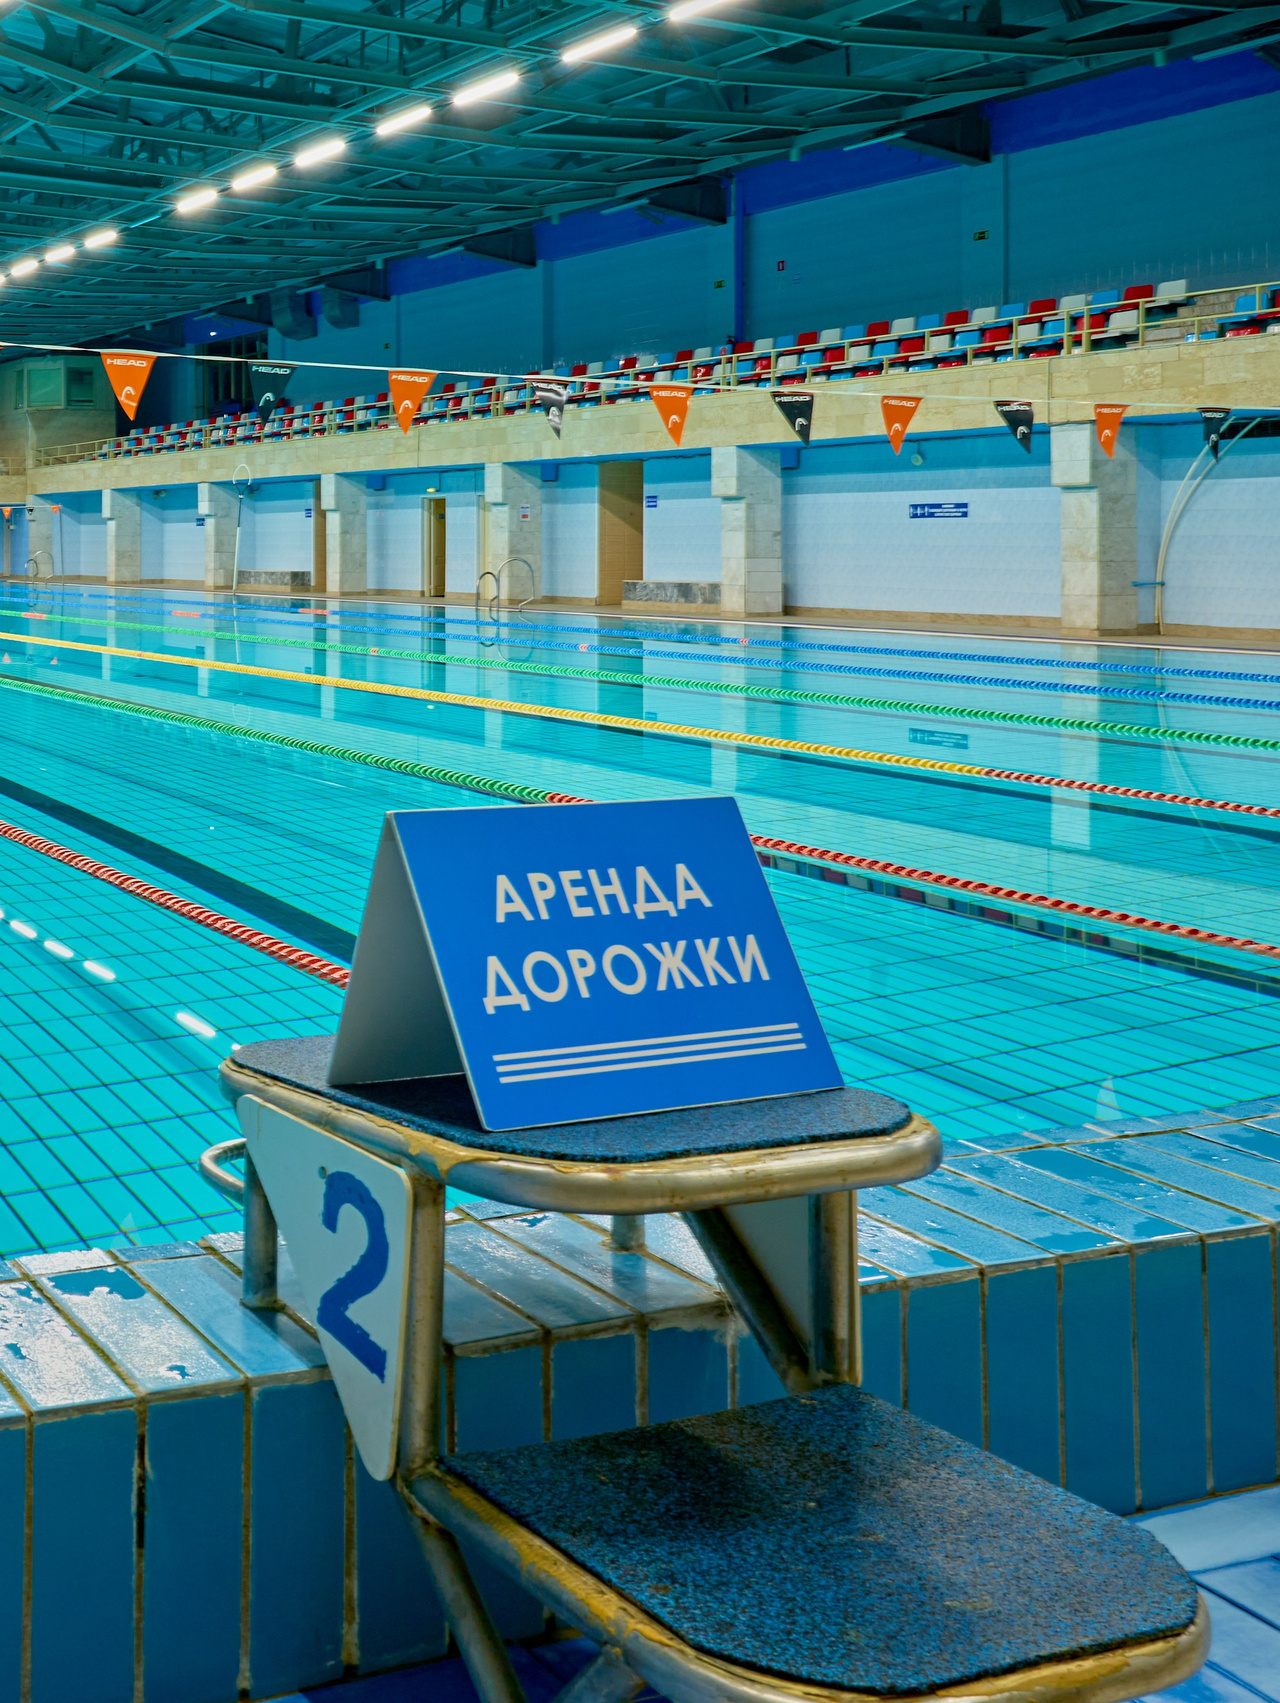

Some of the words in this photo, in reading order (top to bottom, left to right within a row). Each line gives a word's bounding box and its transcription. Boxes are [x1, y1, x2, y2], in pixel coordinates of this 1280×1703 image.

[106, 358, 147, 367] HEAD
[251, 365, 291, 374] HEAD
[391, 375, 429, 383] HEAD
[883, 399, 916, 407] HEAD
[494, 863, 713, 923] АРЕНДА
[481, 933, 771, 1014] ДОРОЖКИ
[317, 1170, 389, 1383] 2
